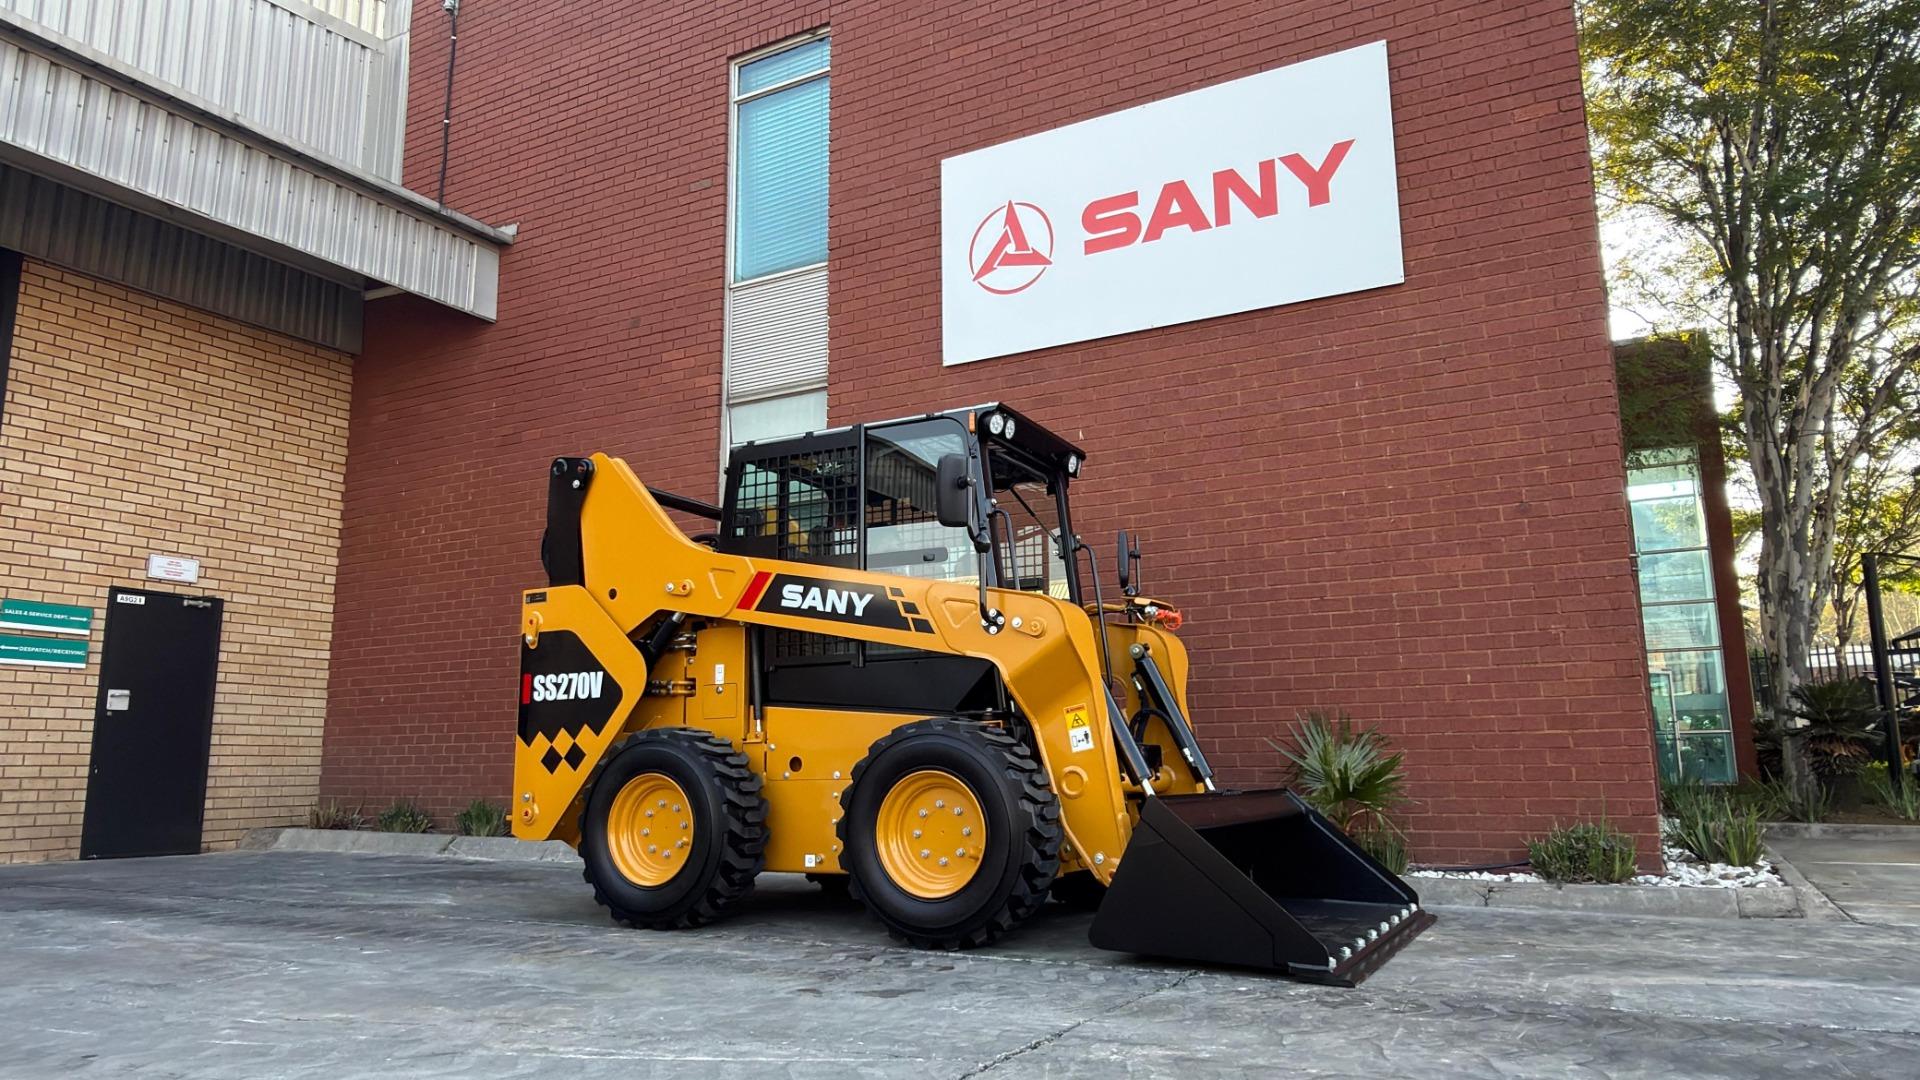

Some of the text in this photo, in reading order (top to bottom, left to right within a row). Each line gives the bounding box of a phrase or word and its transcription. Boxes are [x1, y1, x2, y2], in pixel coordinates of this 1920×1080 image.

[1081, 138, 1356, 255] SANY
[780, 584, 874, 617] SANY
[19, 646, 86, 656] DESPATCH/RECEIVING
[533, 671, 604, 702] SS270V
